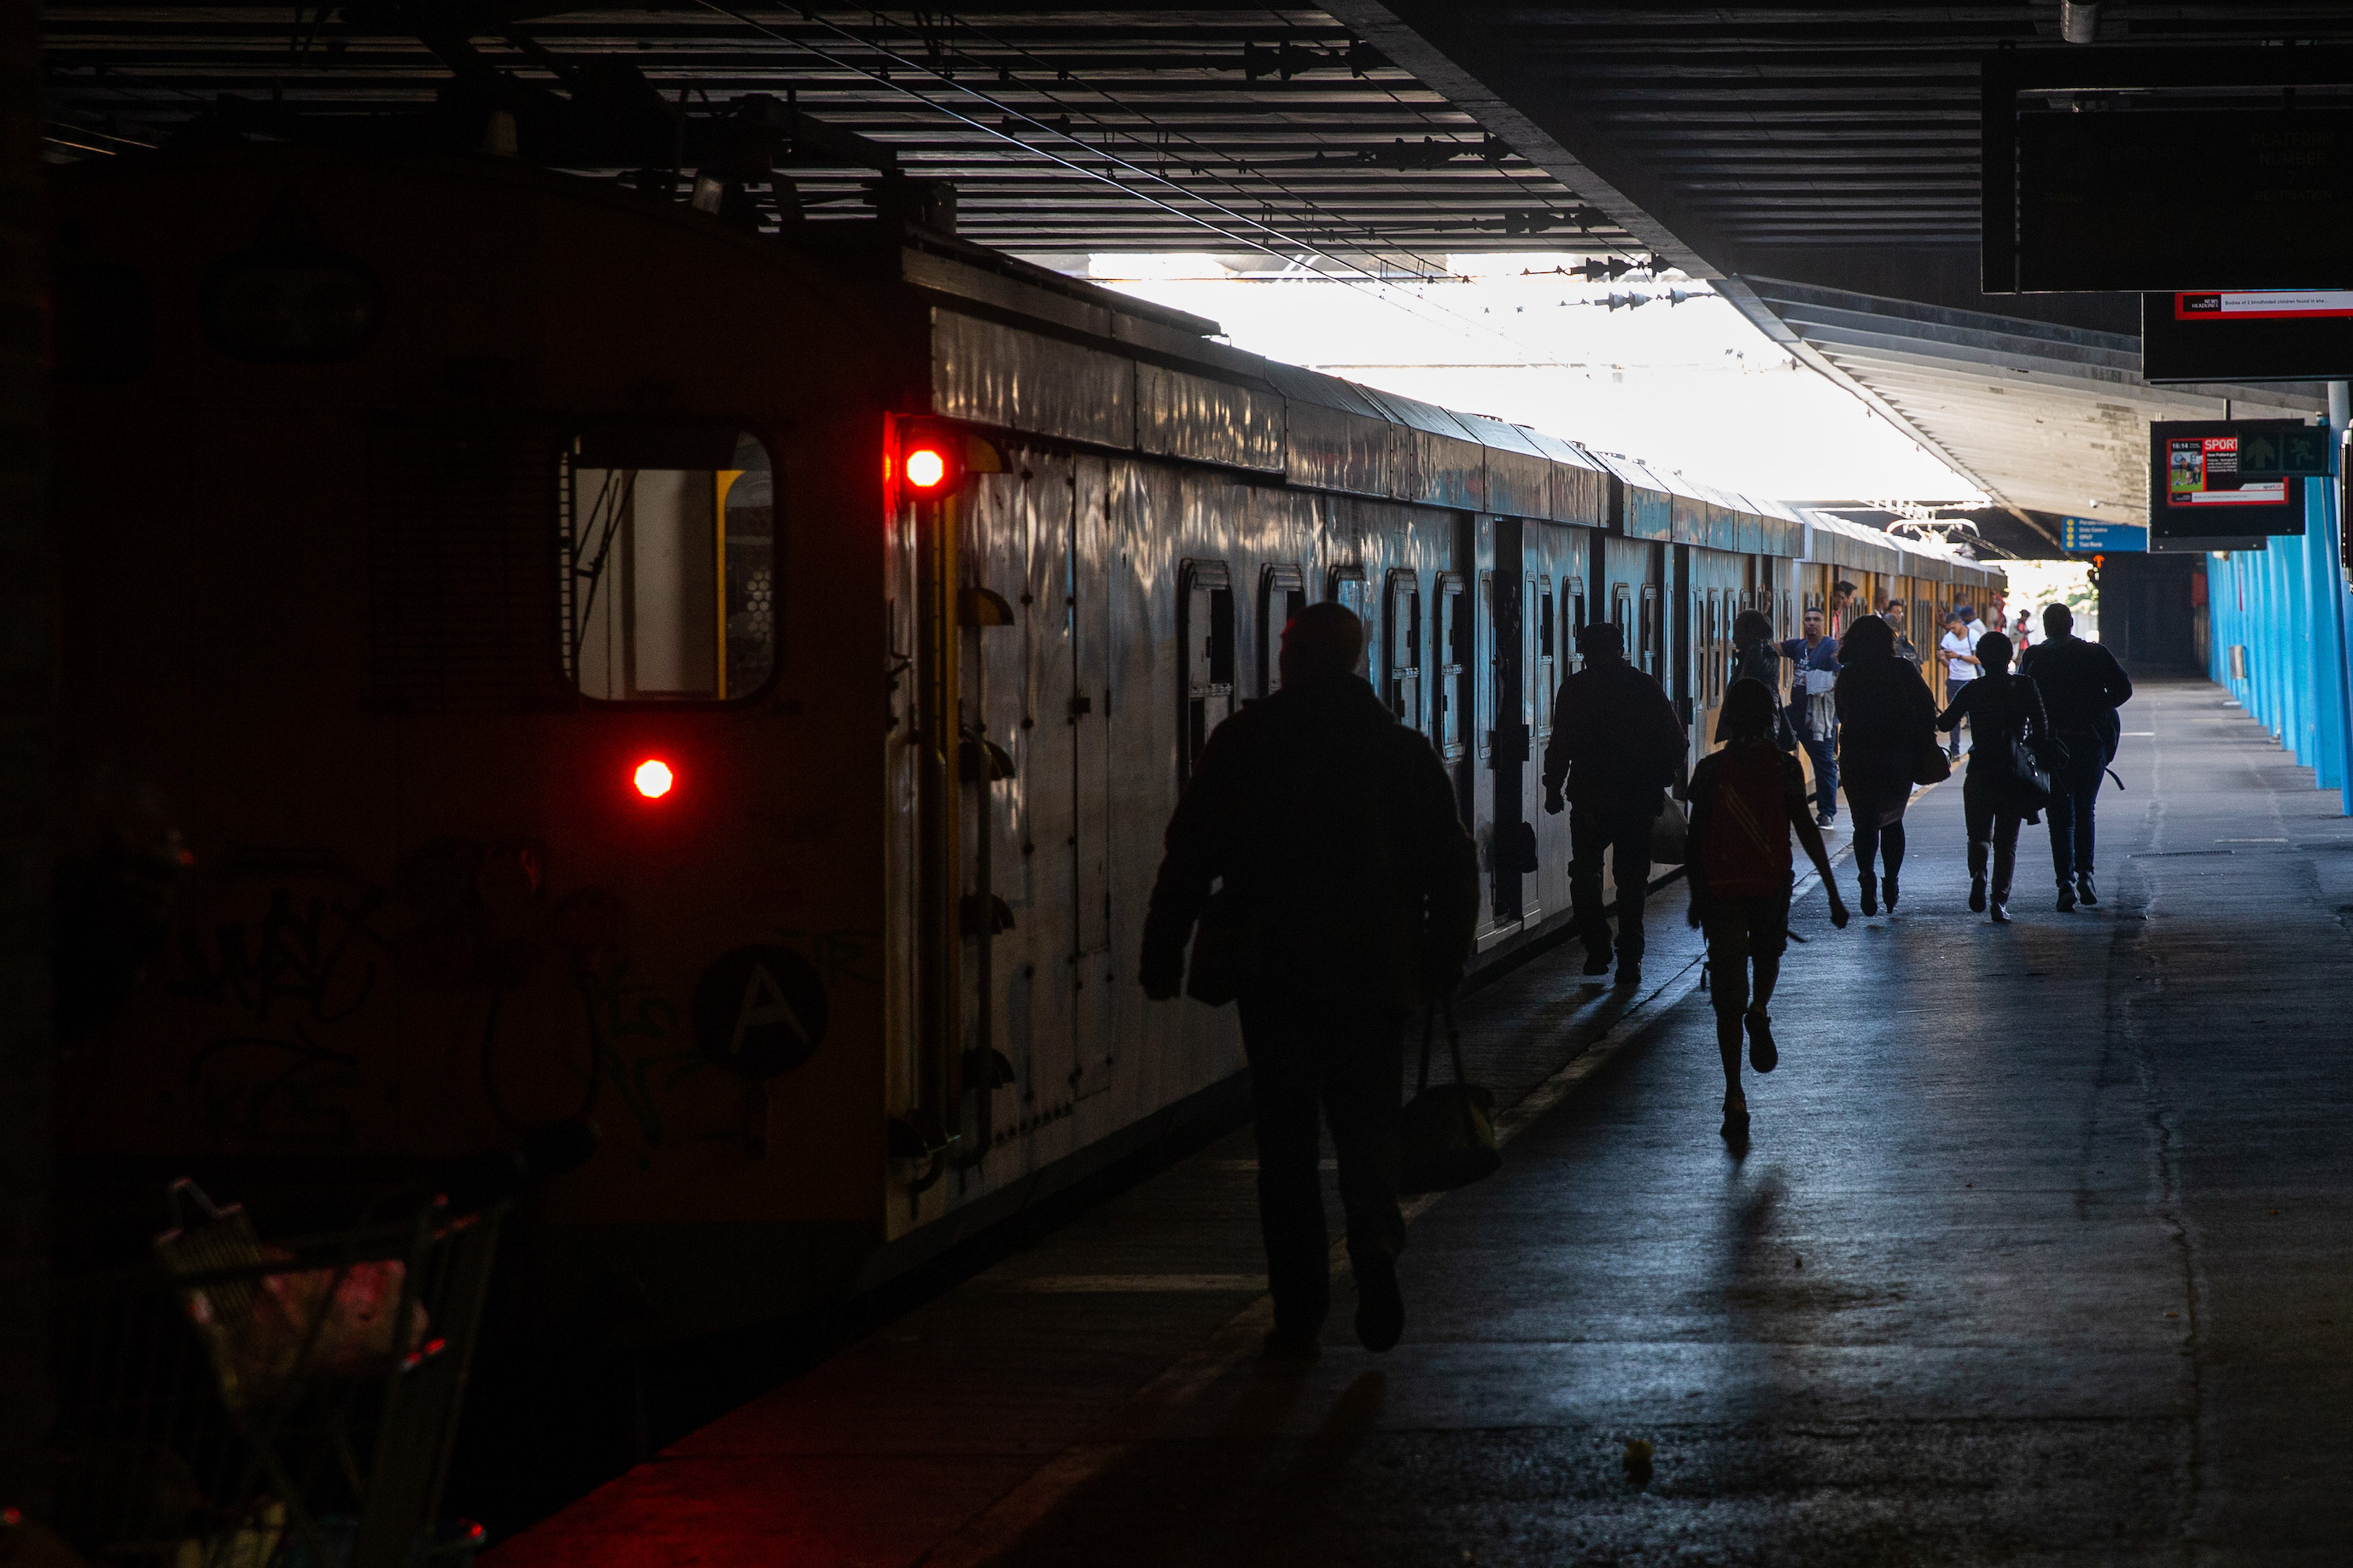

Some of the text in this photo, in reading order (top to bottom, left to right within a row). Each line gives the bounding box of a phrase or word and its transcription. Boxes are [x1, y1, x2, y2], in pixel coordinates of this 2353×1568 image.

[2251, 130, 2335, 147] PLATFORM
[2258, 149, 2327, 166] NUMBER
[2254, 189, 2333, 201] DESTINATION
[2204, 439, 2238, 451] SPORT
[729, 963, 810, 1057] A
